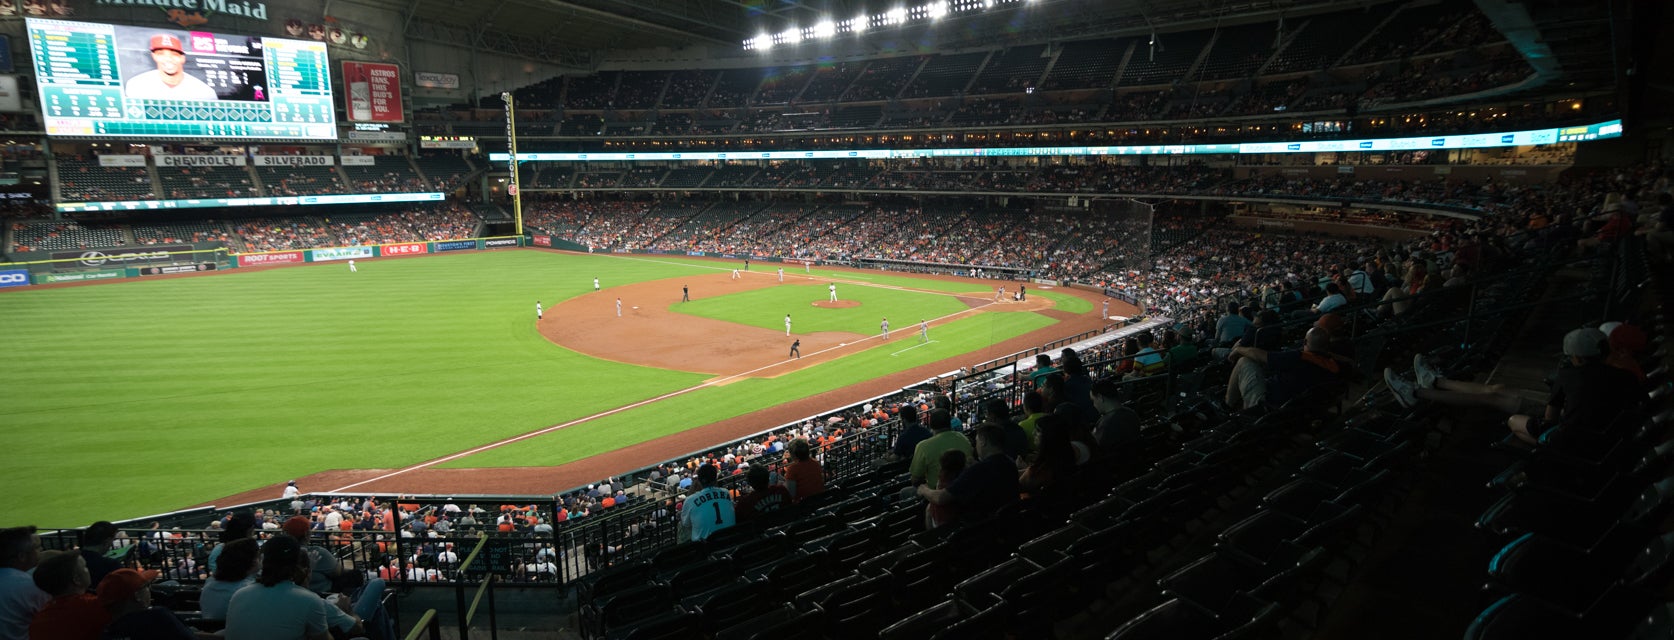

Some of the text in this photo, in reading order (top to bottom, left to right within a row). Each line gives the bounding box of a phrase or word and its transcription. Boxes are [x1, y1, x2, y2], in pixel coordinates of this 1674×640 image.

[203, 0, 267, 20] Maid
[371, 69, 395, 77] ASTROS
[371, 77, 390, 85] FANS,
[372, 91, 392, 99] BUD'S
[164, 156, 238, 166] CHEVROLET
[264, 156, 326, 165] SILVERADO
[244, 254, 268, 262] ROOT
[269, 253, 297, 261] SPORTS
[694, 491, 731, 507] CORREA
[713, 502, 723, 525] 1
